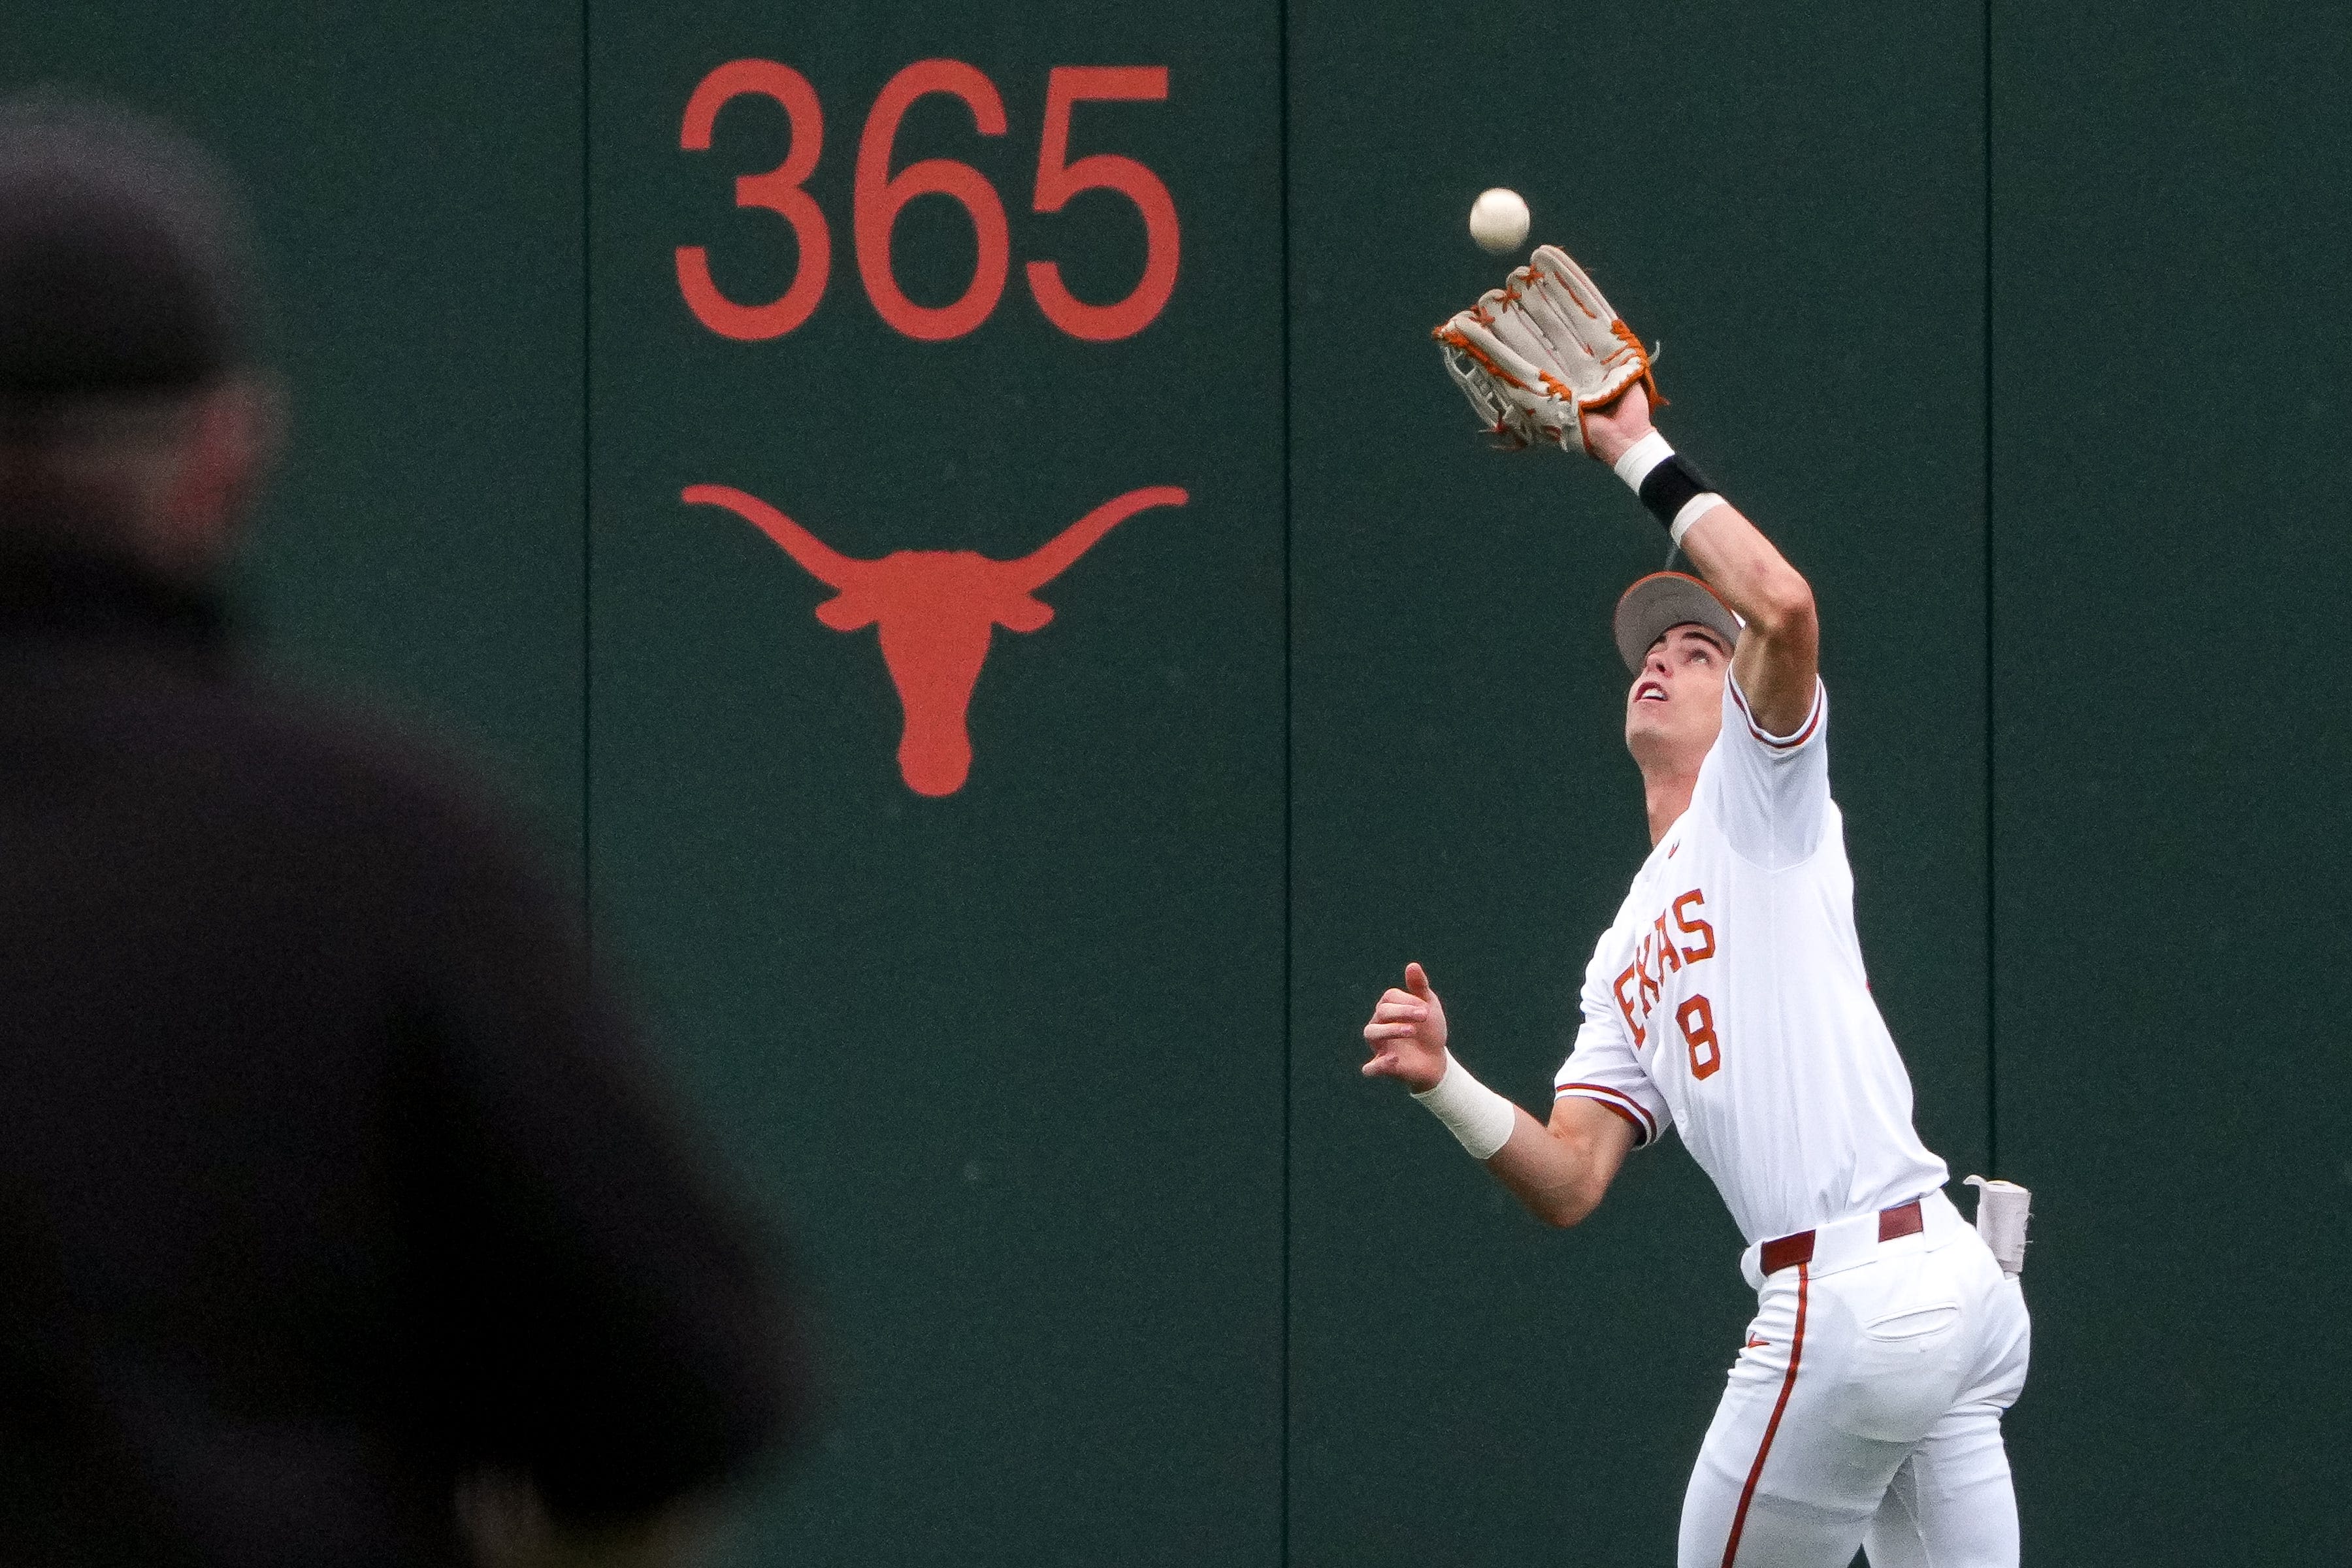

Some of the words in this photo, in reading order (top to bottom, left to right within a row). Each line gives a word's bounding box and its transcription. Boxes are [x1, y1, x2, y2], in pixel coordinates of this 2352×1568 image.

[674, 57, 1181, 341] 365
[1613, 889, 1716, 1051] EXAS
[1675, 993, 1722, 1081] 8
